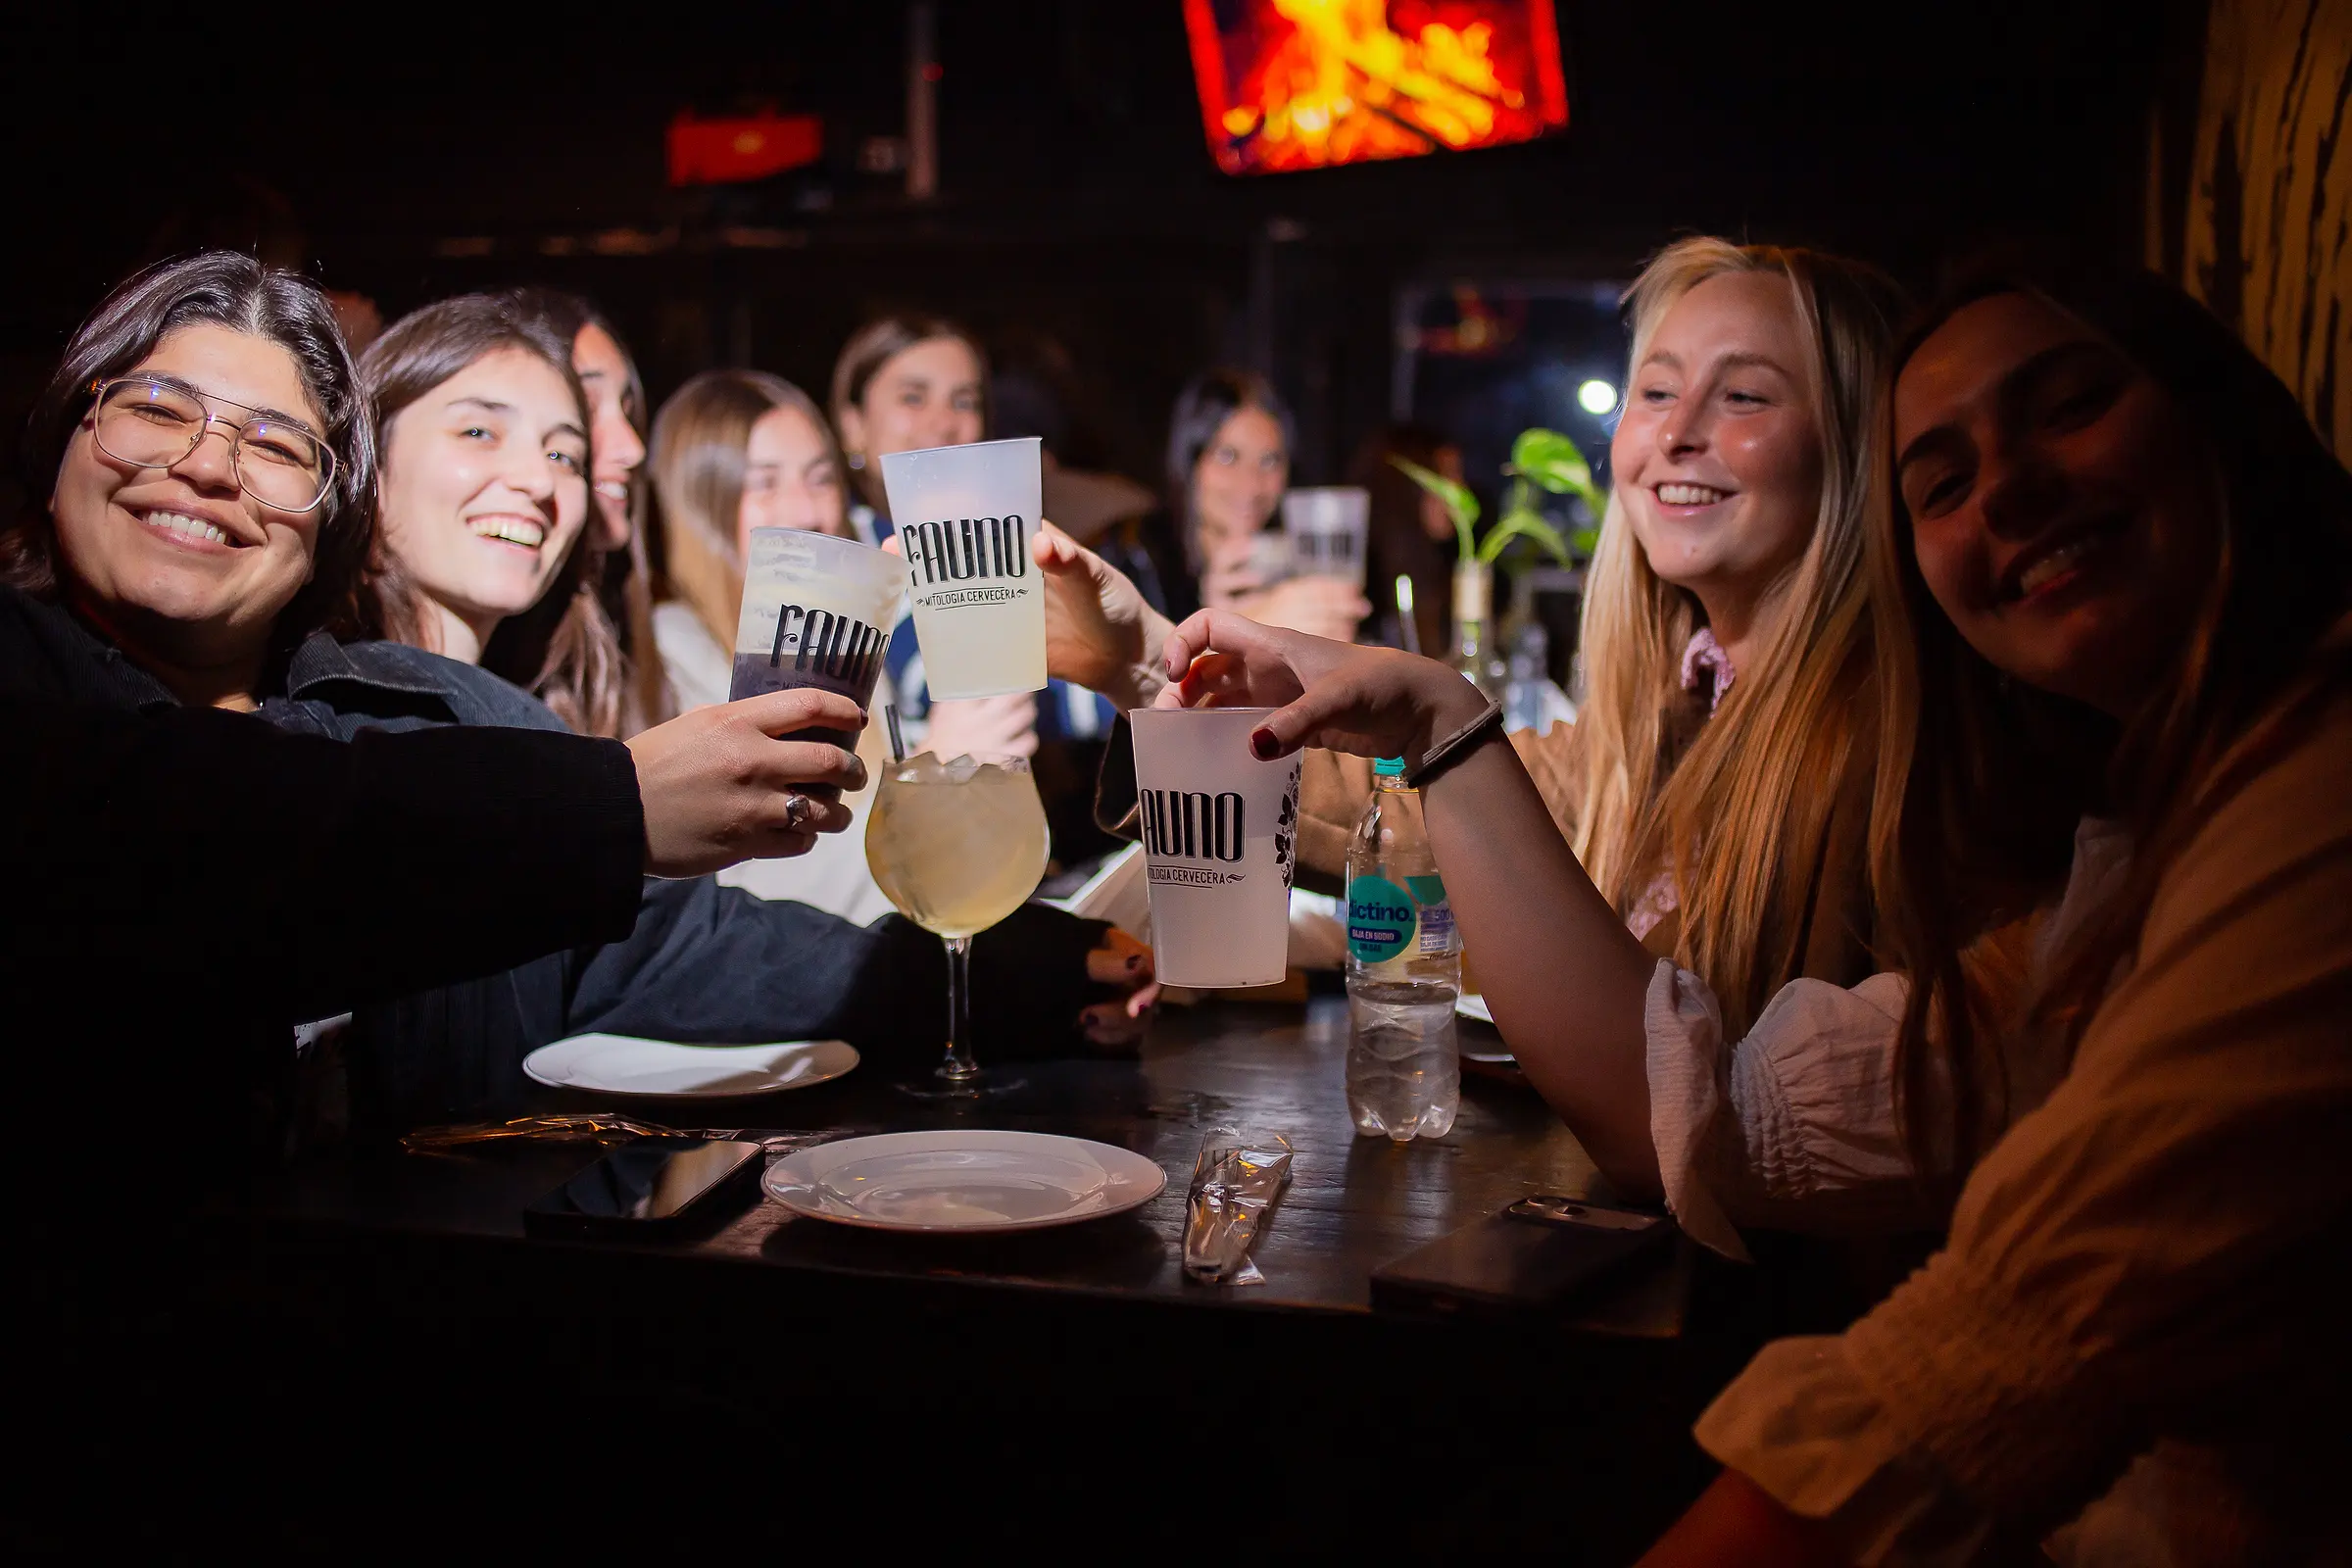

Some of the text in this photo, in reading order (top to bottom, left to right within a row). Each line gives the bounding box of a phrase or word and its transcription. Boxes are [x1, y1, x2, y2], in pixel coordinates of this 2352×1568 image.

[902, 514, 1027, 587] FAUNO
[924, 588, 1015, 607] MITOLOGIA CERVECERA
[1140, 789, 1247, 862] AUNO
[1173, 869, 1225, 885] CERVECERA
[1348, 898, 1409, 922] dictino
[1374, 932, 1395, 941] SODIO
